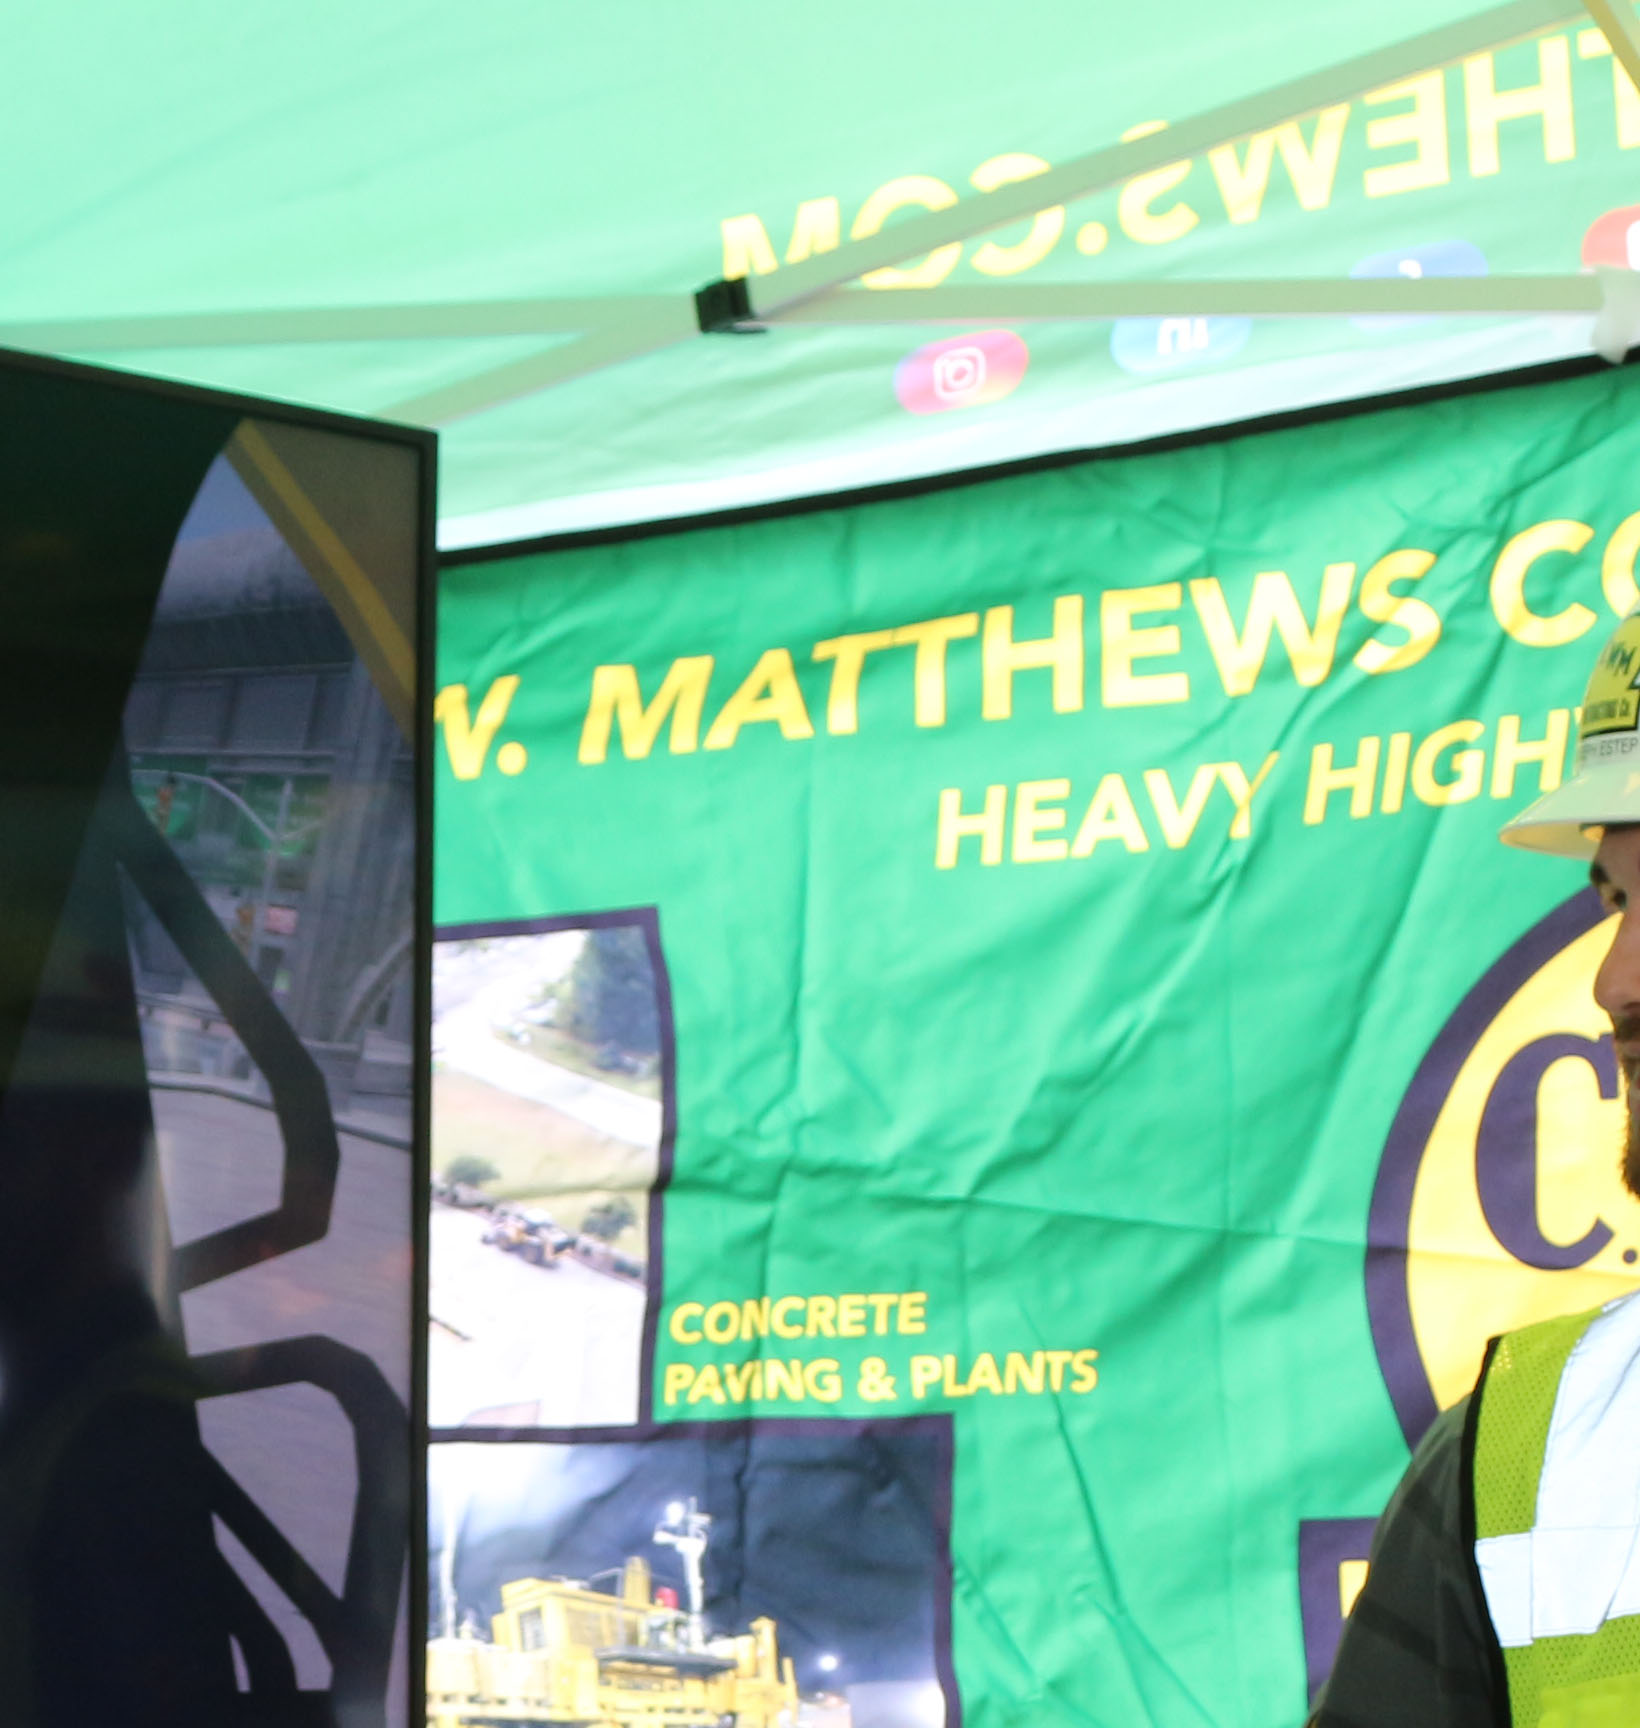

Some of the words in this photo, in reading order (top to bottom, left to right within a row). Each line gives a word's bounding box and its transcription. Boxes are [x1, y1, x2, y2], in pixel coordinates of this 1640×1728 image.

[576, 548, 1443, 766] MATTHEWS
[934, 750, 1281, 870] HEAVY
[1302, 706, 1584, 826] HIGH
[668, 1291, 928, 1345] CONCRETE
[663, 1358, 843, 1406] PAVING
[857, 1356, 899, 1404] &
[909, 1348, 1099, 1400] PLANTS
